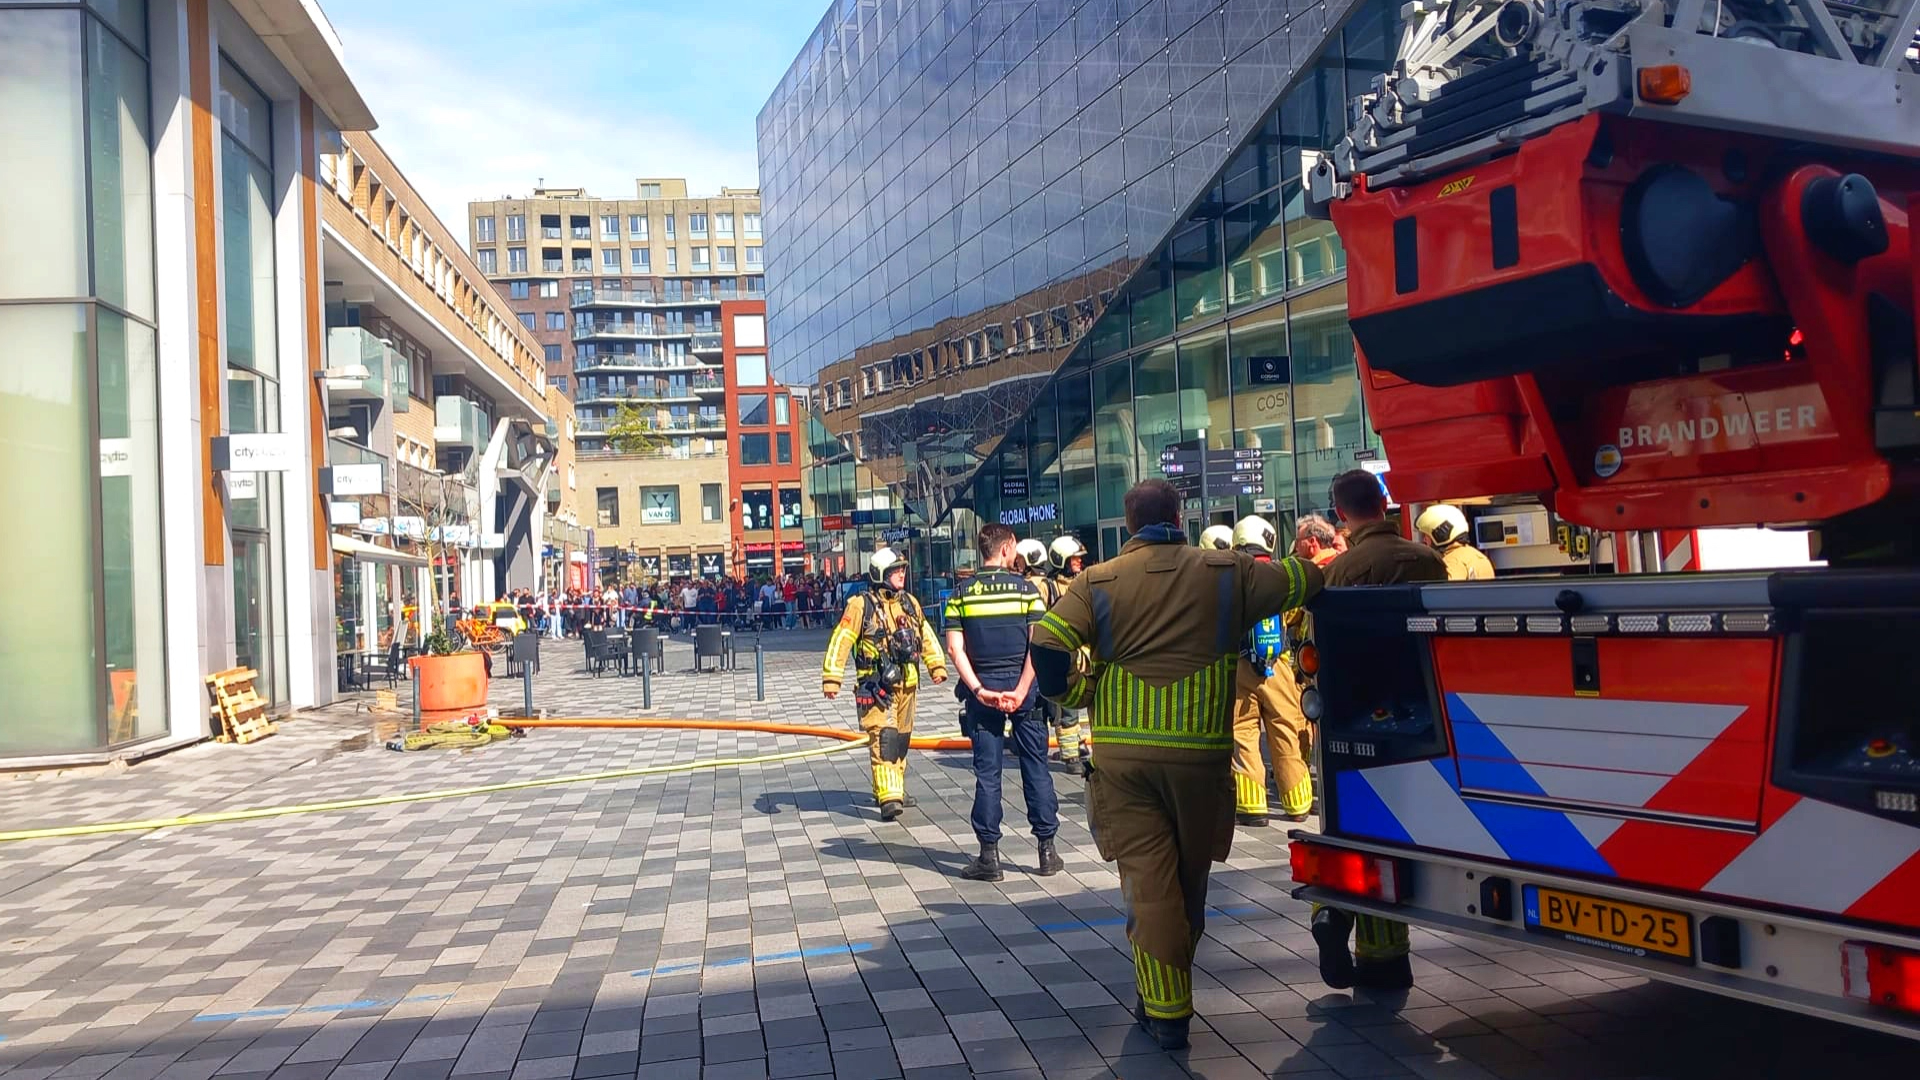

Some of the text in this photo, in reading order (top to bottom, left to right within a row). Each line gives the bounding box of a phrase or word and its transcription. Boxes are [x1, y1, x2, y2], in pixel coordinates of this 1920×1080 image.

[1619, 405, 1817, 448] BRANDWEER
[648, 510, 662, 518] VAN
[1000, 503, 1056, 525] GLOBAL PHONE
[1527, 908, 1539, 919] NL
[1548, 896, 1679, 948] BV-TD-25
